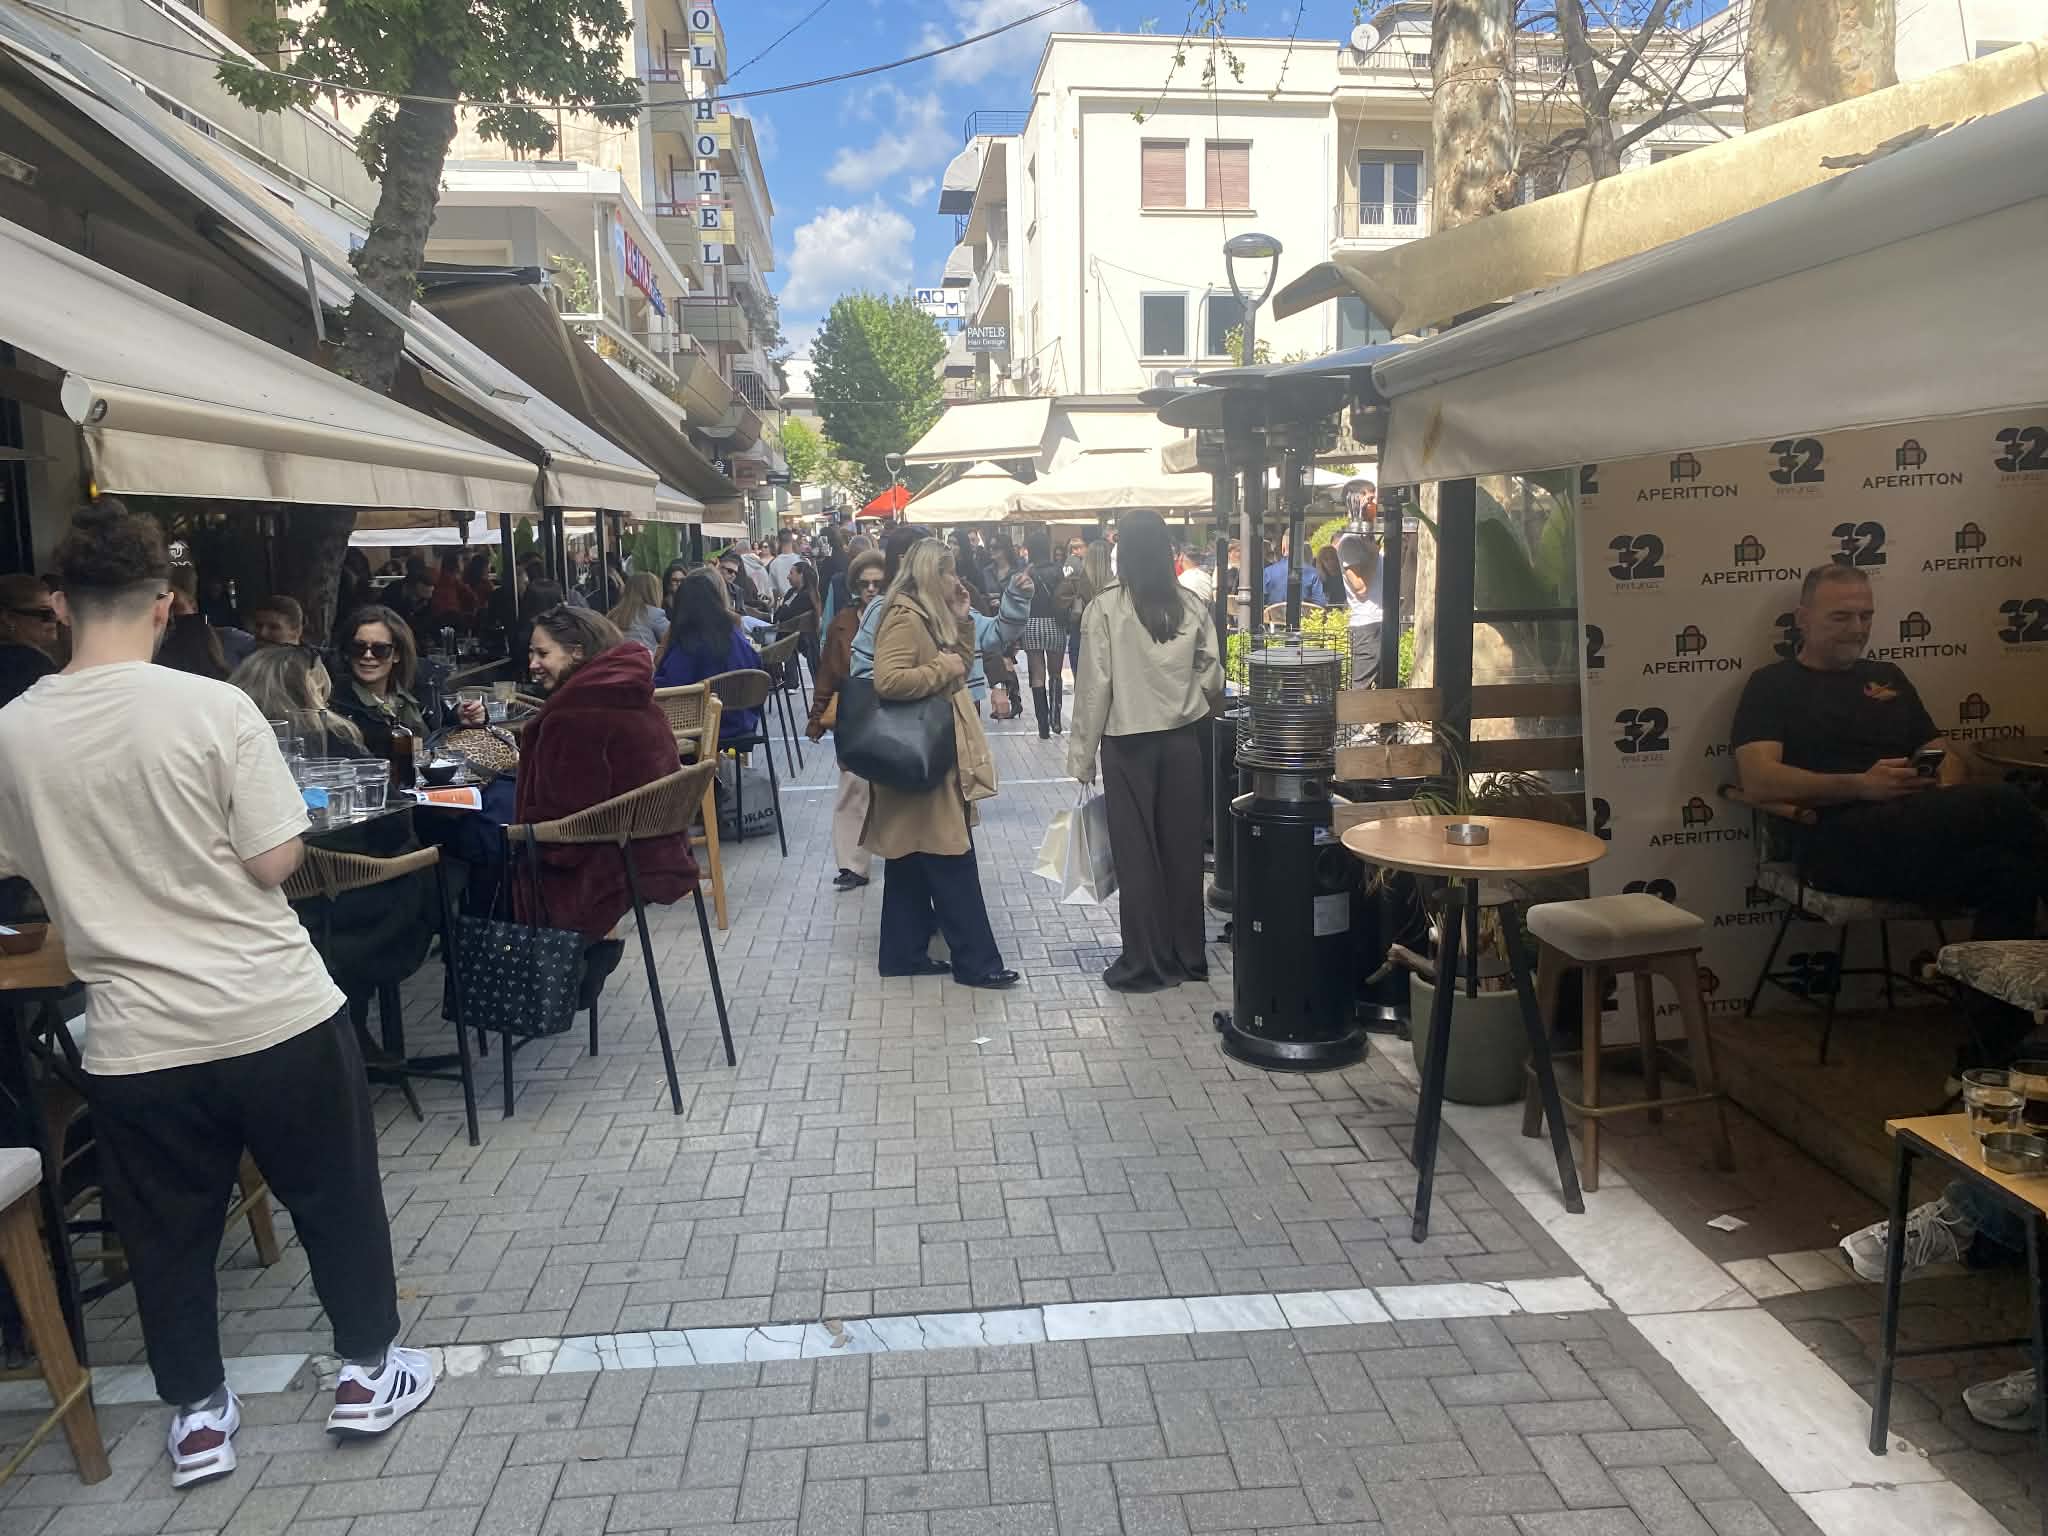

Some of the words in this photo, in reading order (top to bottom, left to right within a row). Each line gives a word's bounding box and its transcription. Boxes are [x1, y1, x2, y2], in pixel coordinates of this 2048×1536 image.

[697, 99, 721, 263] HOTEL
[967, 326, 1005, 338] PANTELIS
[1769, 437, 1825, 485] 32
[1863, 472, 1963, 490] APERITTON
[1637, 485, 1738, 503] APERITTON
[1831, 521, 1887, 567] 32
[1608, 534, 1664, 580] 32
[1921, 554, 2022, 573] APERITTON
[1701, 567, 1801, 586] APERITTON
[1866, 643, 1967, 662] APERITTON
[1642, 657, 1742, 676] APERITTON
[1614, 707, 1670, 754] 32
[1935, 724, 2025, 742] PERITTON
[1649, 827, 1750, 848] APERITTON
